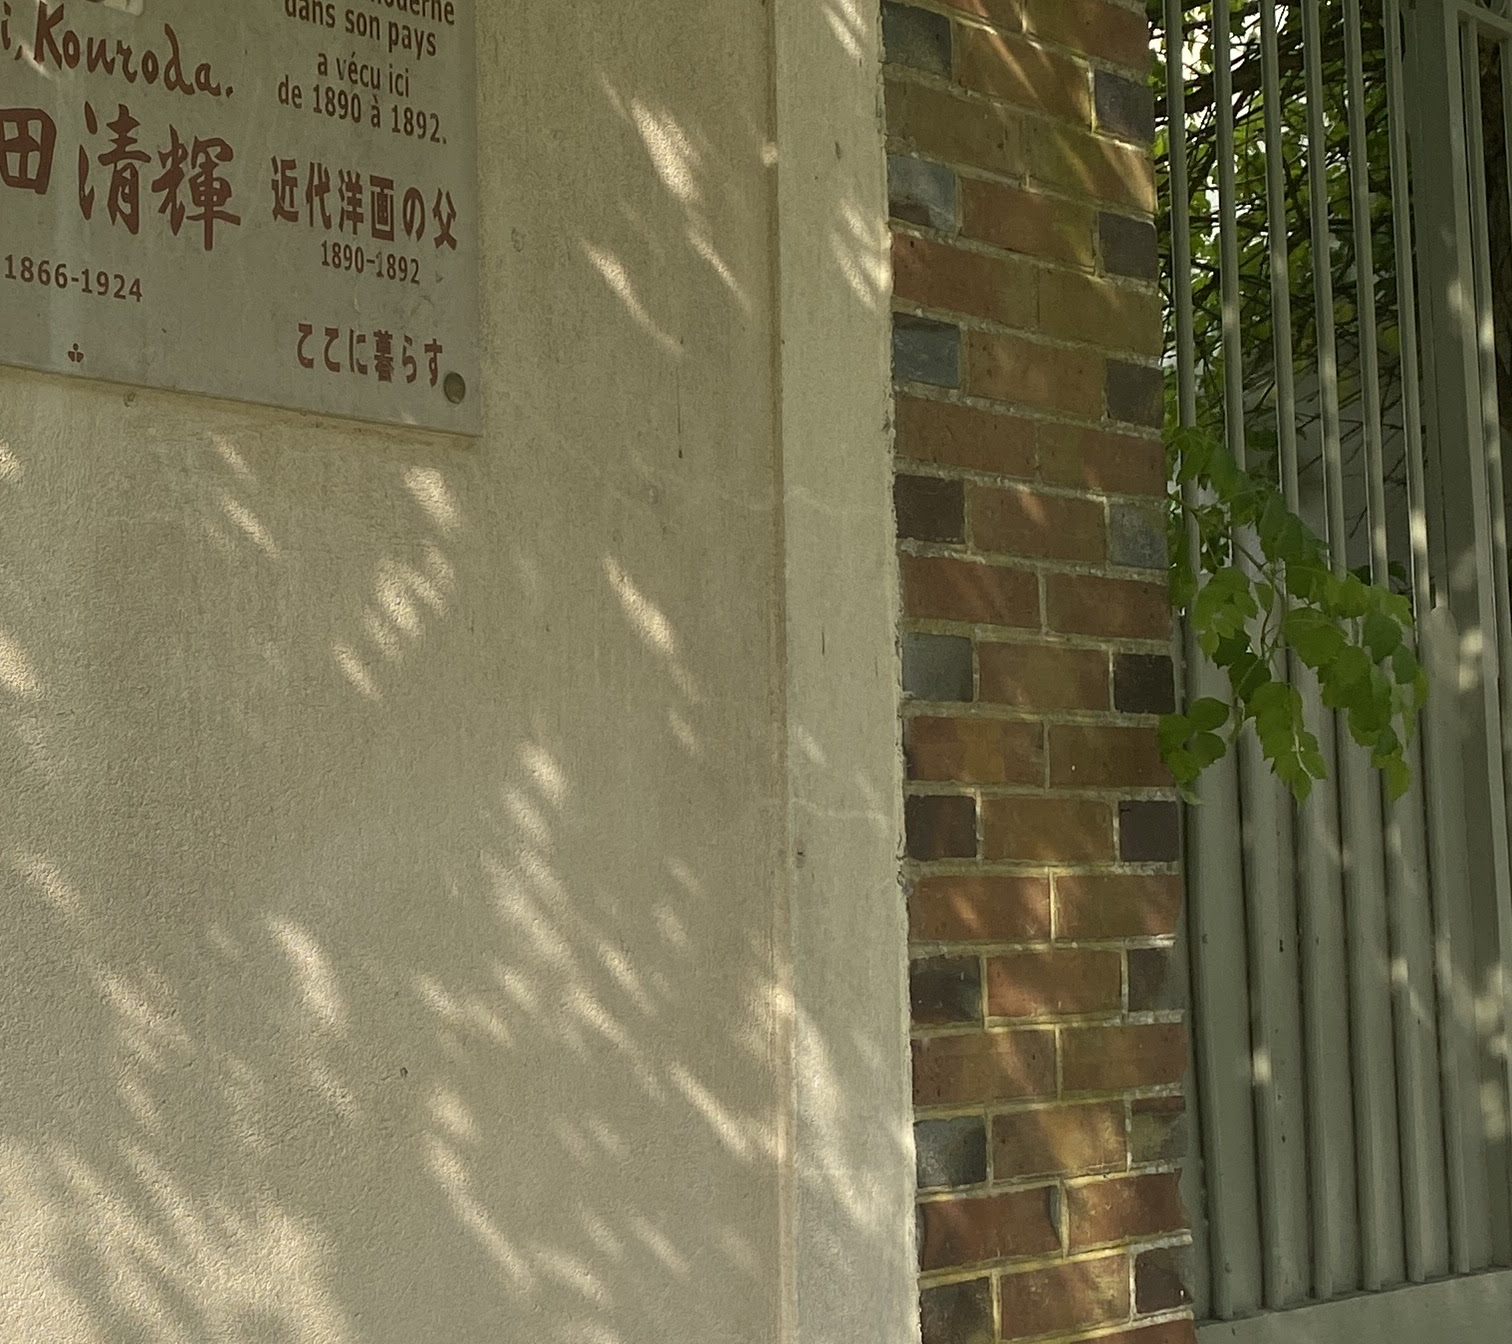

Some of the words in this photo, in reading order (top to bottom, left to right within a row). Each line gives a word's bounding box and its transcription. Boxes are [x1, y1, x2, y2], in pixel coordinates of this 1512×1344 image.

[345, 8, 381, 41] son
[388, 20, 437, 61] pays
[317, 52, 329, 77] a
[336, 51, 381, 91] vécu
[389, 63, 410, 98] ici
[278, 74, 303, 110] de
[312, 84, 362, 124] 1890
[370, 94, 381, 129] à
[391, 104, 447, 145] 1892.
[271, 155, 458, 251] 近代洋画の父
[4, 254, 143, 303] 1866-1924
[321, 240, 420, 285] 1890-1892
[297, 323, 443, 388] ここに暮らす
